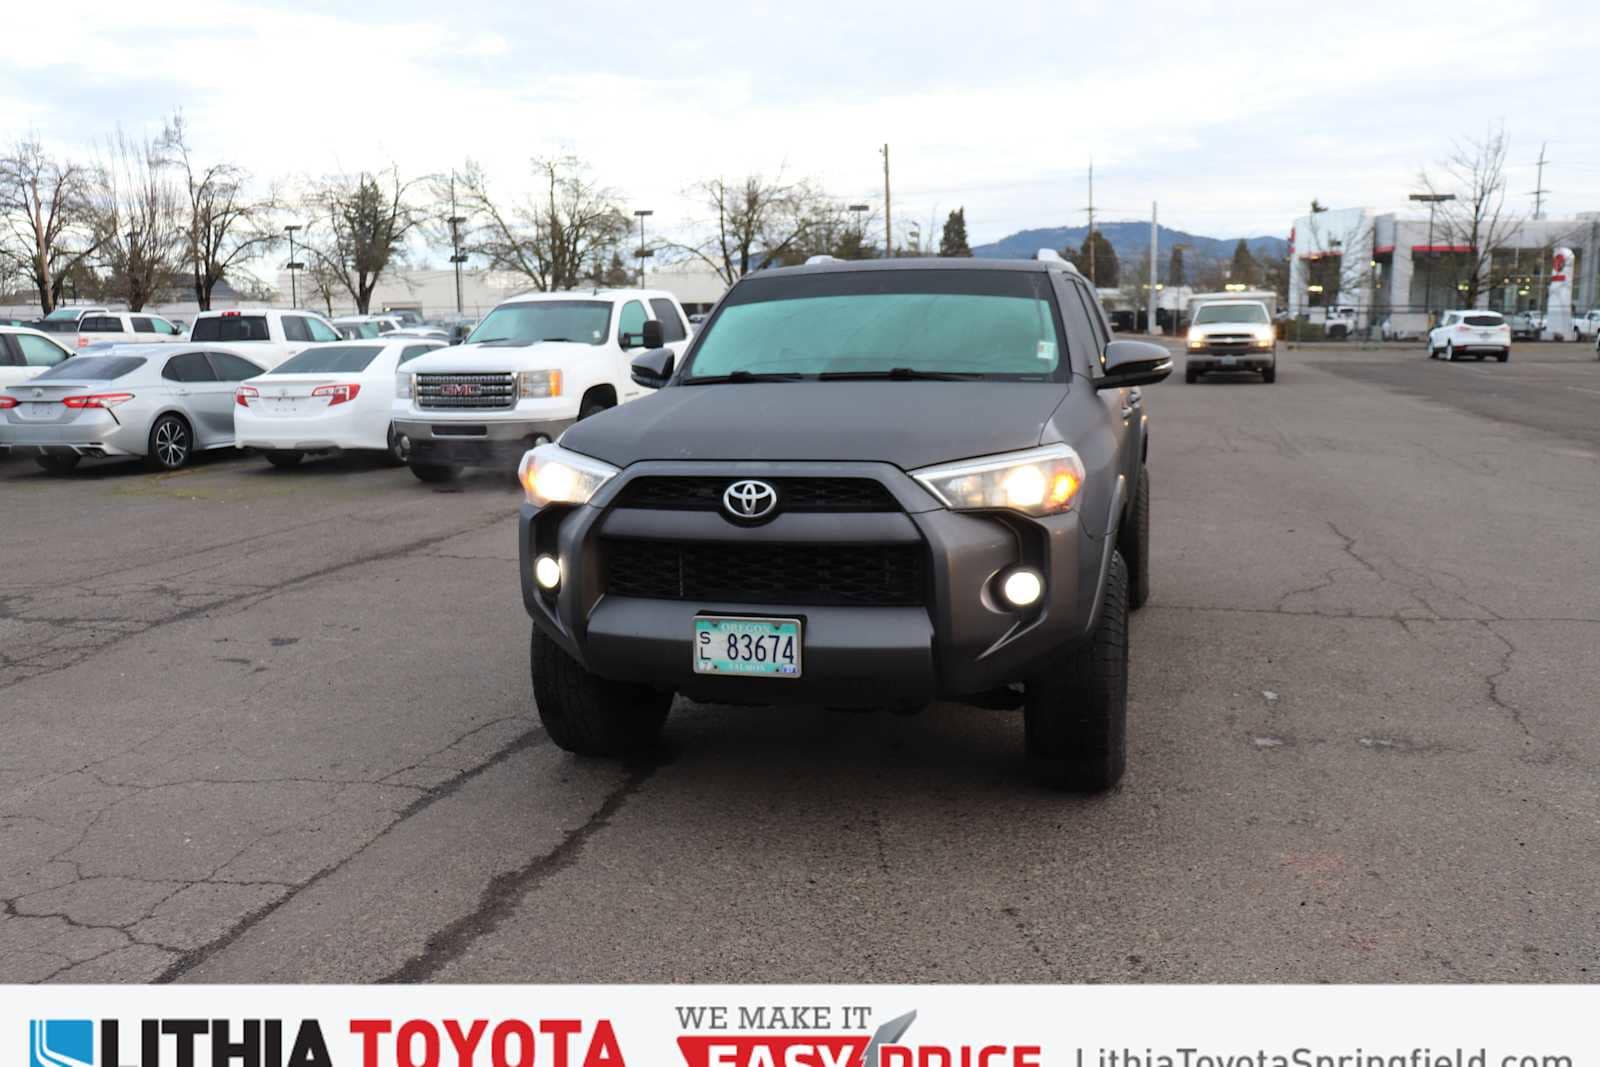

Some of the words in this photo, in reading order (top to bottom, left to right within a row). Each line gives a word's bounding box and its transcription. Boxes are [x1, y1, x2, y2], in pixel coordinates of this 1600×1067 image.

[440, 384, 480, 395] GMC
[720, 622, 770, 633] OREGON
[727, 633, 794, 663] 83674
